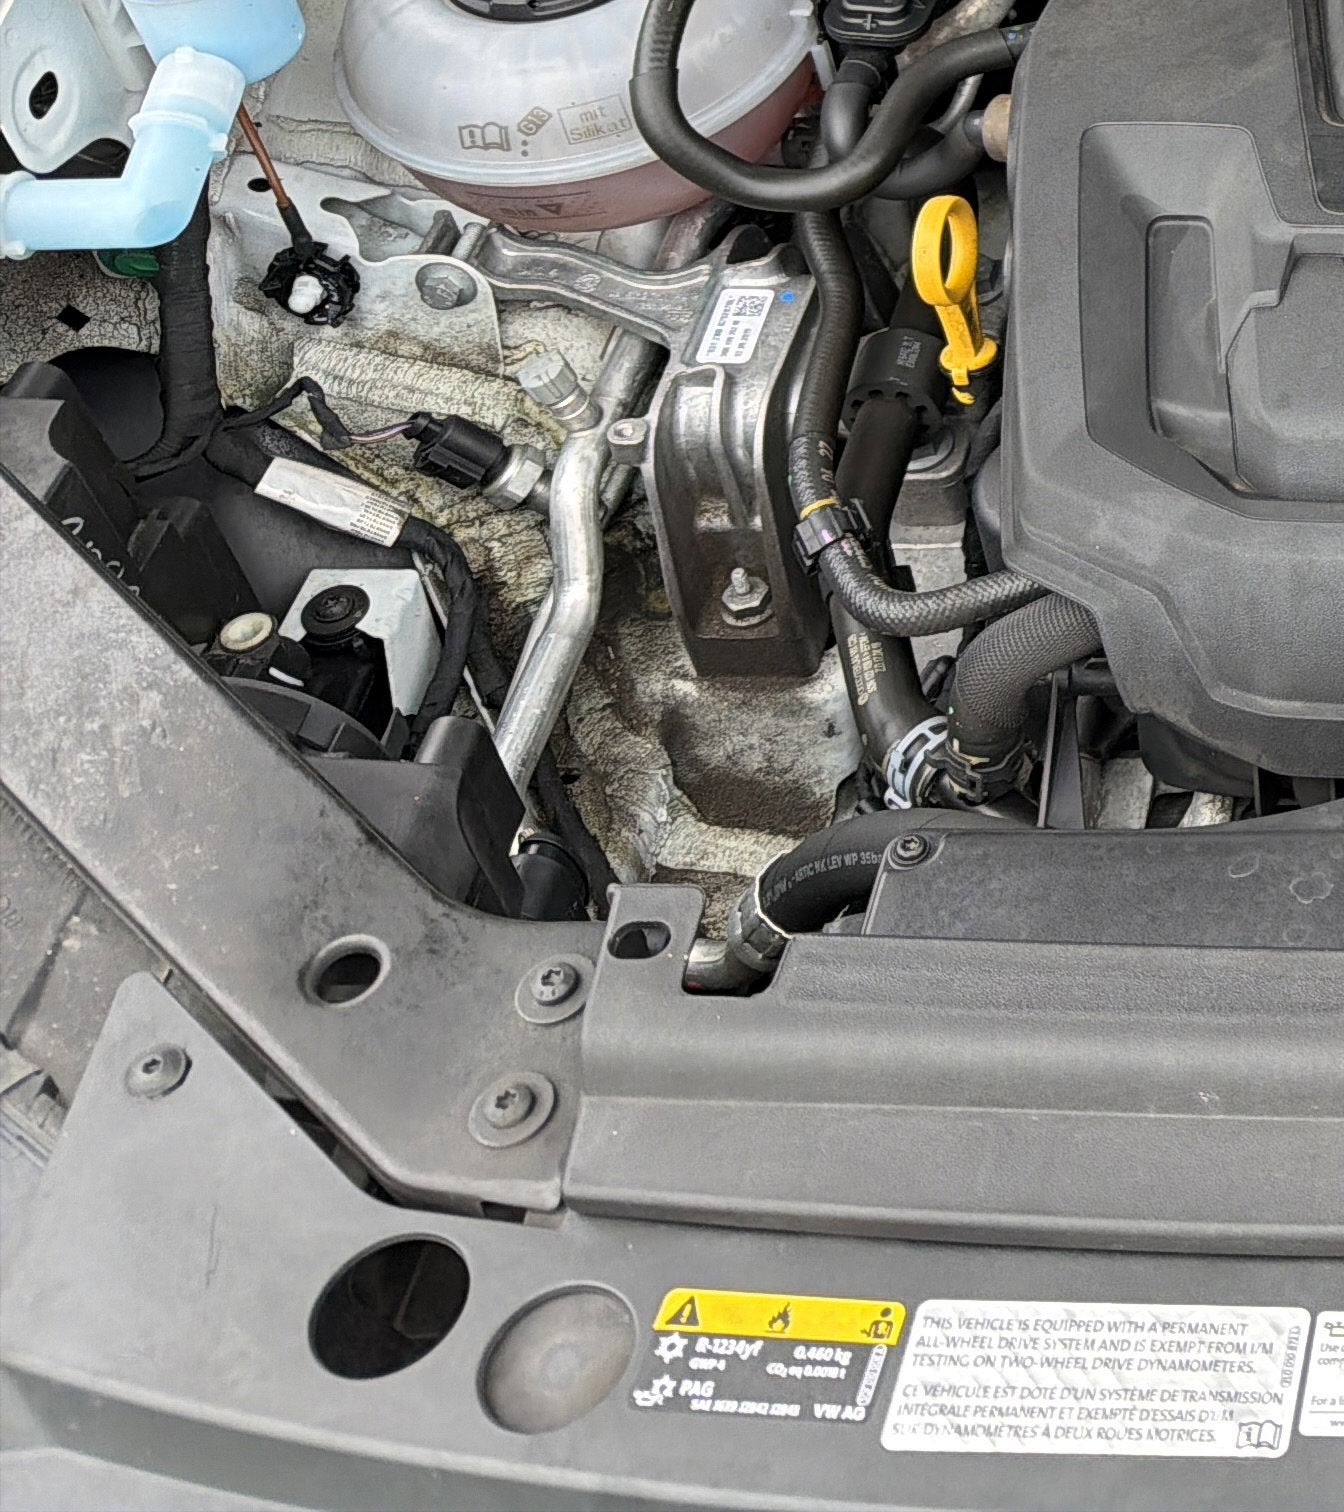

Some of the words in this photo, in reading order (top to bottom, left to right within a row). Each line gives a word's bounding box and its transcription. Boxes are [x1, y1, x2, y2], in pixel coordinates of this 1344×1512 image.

[579, 105, 607, 123] mit
[919, 1315, 955, 1329] THIS
[955, 1316, 1015, 1331] VEHICLE
[1015, 1317, 1032, 1331] IS
[1031, 1318, 1105, 1335] EQUIPPED
[1104, 1319, 1146, 1334] WITH
[1146, 1320, 1160, 1334] A
[1160, 1320, 1248, 1336] PERMANENT
[695, 1336, 764, 1360] R-1234yf
[914, 1334, 996, 1350] ALL-WHEEL
[996, 1336, 1041, 1351] DRIVE
[1042, 1337, 1096, 1352] SYSTEM
[1096, 1338, 1132, 1353] AND
[1132, 1339, 1147, 1353] IS
[1148, 1339, 1206, 1354] EXEMPT
[1206, 1340, 1248, 1355] FROM
[1319, 1342, 1339, 1352] Use
[909, 1352, 971, 1367] TESTING
[971, 1354, 997, 1368] ON
[997, 1354, 1089, 1370] TWO-WHEEL
[1090, 1356, 1135, 1371] DRIVE
[679, 1378, 716, 1398] PAG
[992, 1384, 1018, 1399] EST
[1158, 1387, 1179, 1403] DE
[1180, 1388, 1284, 1405] TRANSMISSION
[1310, 1394, 1328, 1406] For
[1329, 1397, 1337, 1406] a
[813, 1403, 842, 1420] VW
[841, 1405, 866, 1421] AG
[971, 1402, 1058, 1419] PERMANENT
[1057, 1404, 1075, 1420] ET
[1053, 1425, 1095, 1440] DEUX
[1095, 1426, 1144, 1441] ROUES
